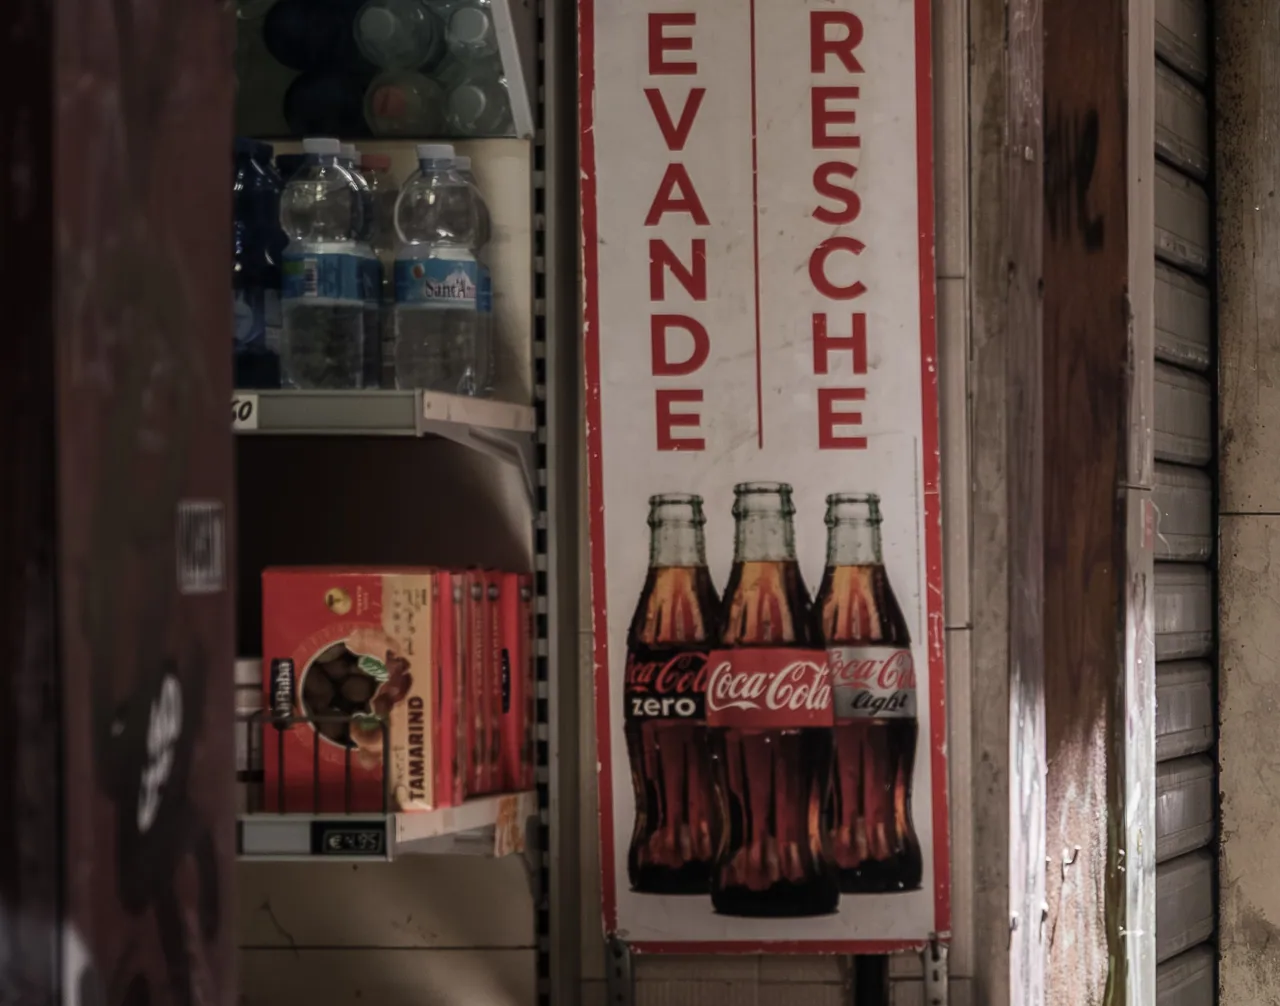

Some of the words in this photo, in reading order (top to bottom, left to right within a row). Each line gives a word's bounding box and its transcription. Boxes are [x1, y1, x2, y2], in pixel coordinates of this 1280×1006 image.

[631, 696, 697, 717] zero
[707, 660, 832, 711] Coca-Cola
[407, 696, 425, 802] TAMARIND
